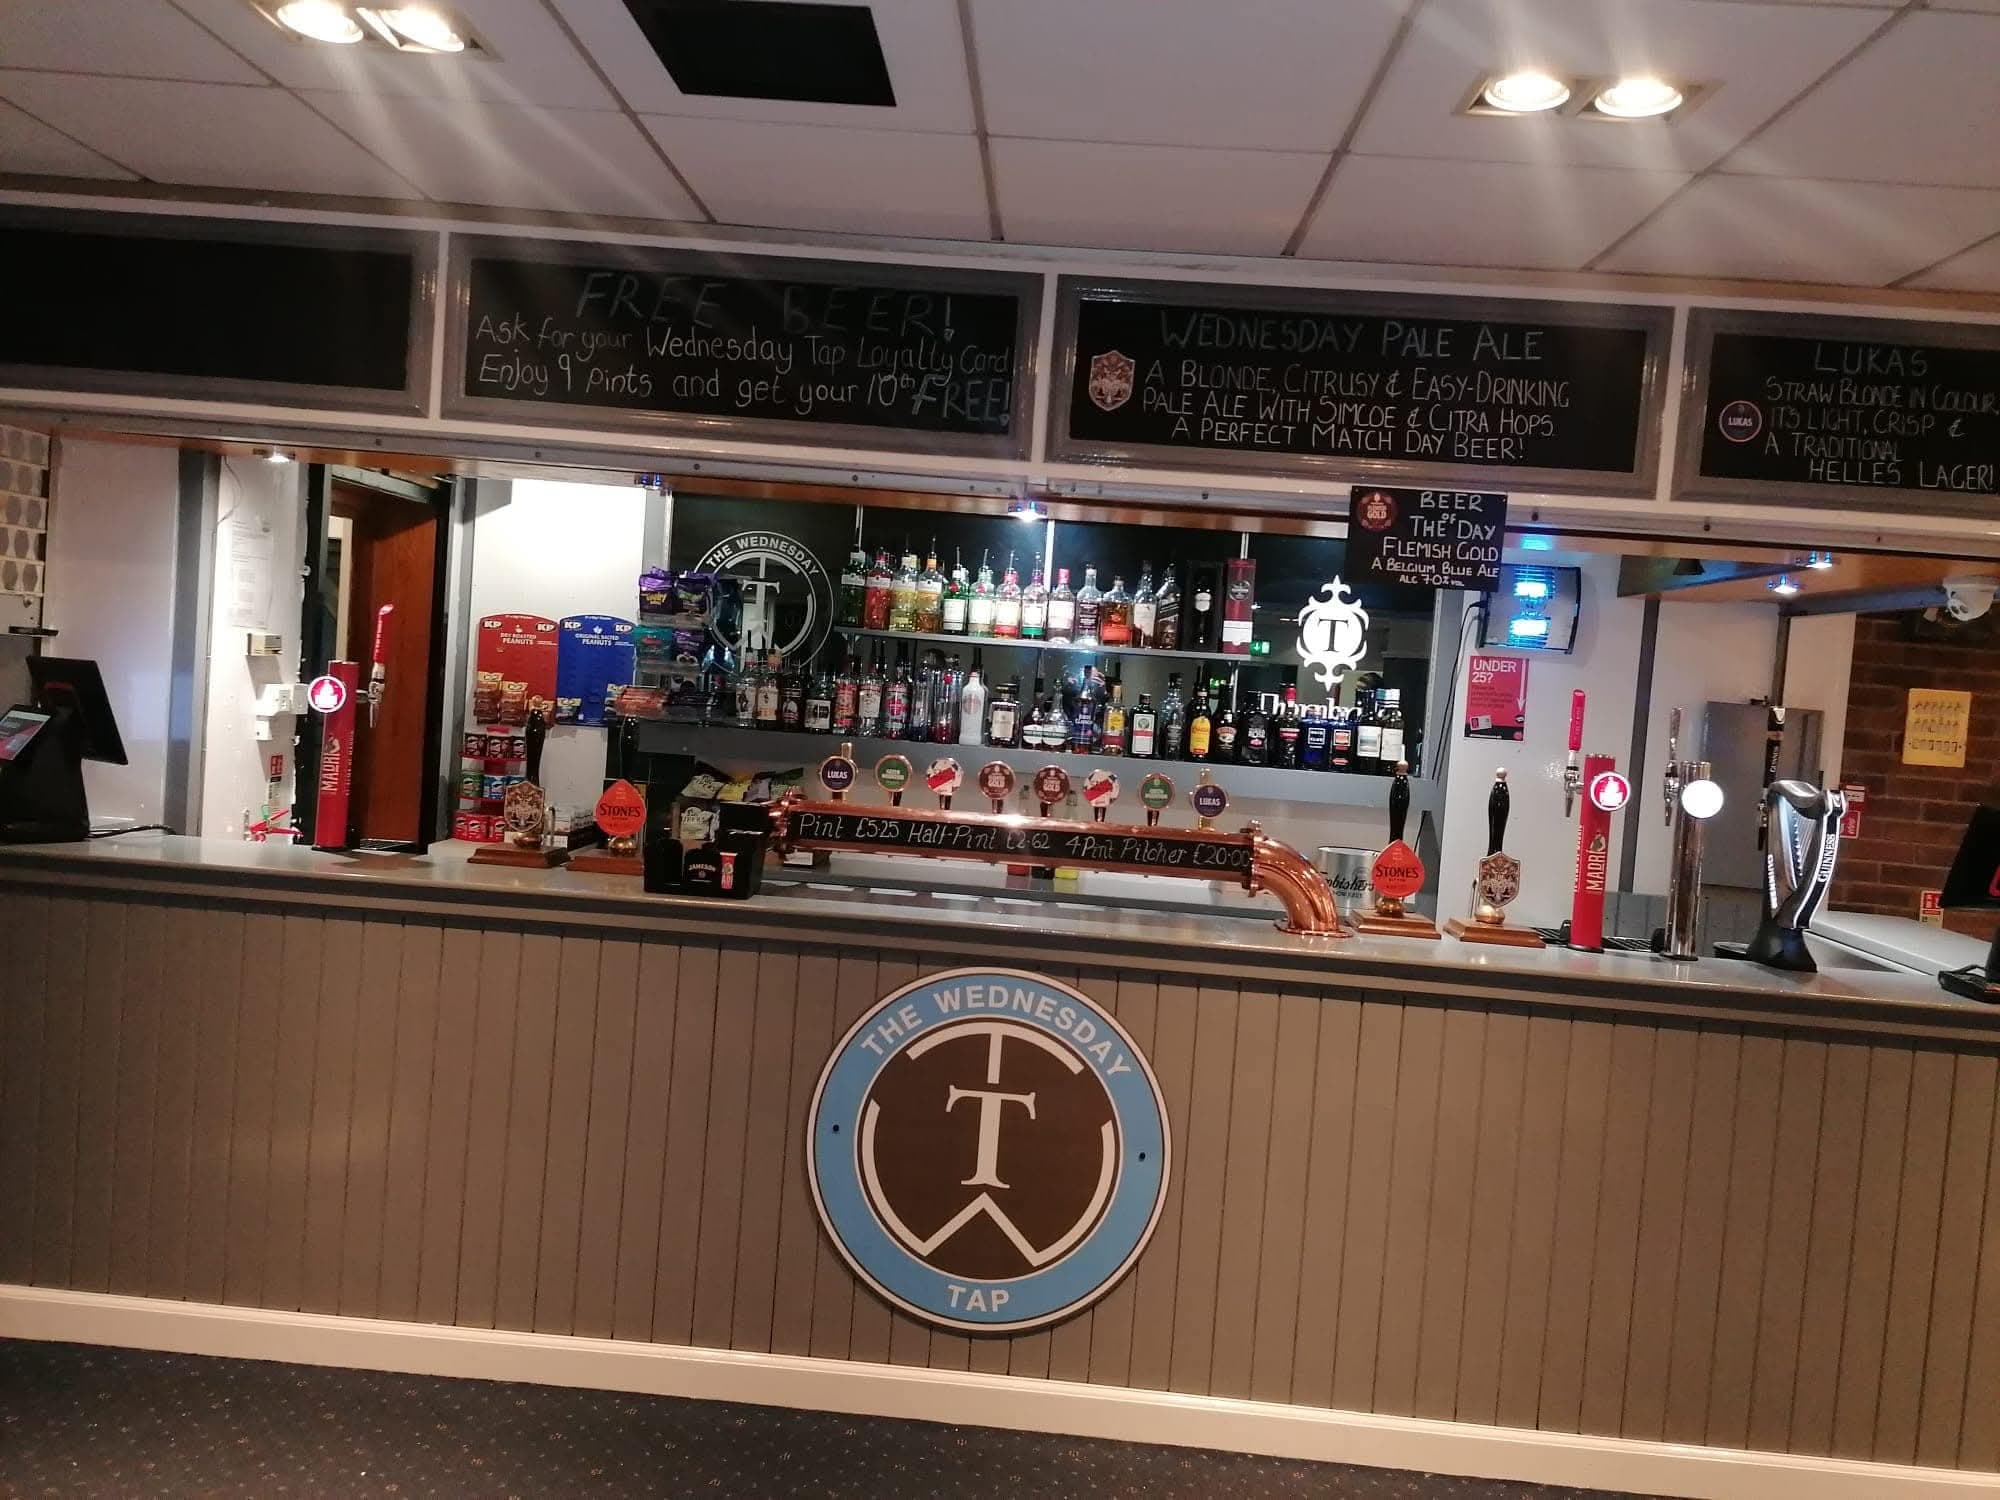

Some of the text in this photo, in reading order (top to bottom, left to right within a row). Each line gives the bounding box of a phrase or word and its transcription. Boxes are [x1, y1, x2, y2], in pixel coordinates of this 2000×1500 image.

[575, 271, 954, 343] FREE BEER!
[475, 315, 532, 344] Ask
[537, 317, 575, 348] for
[575, 330, 634, 363] your
[645, 323, 794, 377] Wednesday
[805, 335, 847, 376] Tap
[1160, 308, 1544, 362] WEDNESDAY PALE ALE
[1813, 342, 1928, 378] LUKAS
[479, 352, 551, 392] Enjoy
[558, 349, 573, 378] 9
[673, 372, 722, 400] and
[735, 375, 786, 409] get
[795, 382, 859, 416] your
[911, 373, 1011, 428] FREE!
[1144, 360, 1166, 384] A
[1283, 367, 1381, 399] CITRUSY
[1385, 370, 1402, 398] &
[1412, 368, 1571, 408] EASY-DRINKING
[1766, 375, 1834, 404] STRAW
[1839, 376, 1905, 409] BLONDE
[1909, 384, 1926, 408] IN
[1142, 387, 1194, 415] PALE
[1202, 393, 1251, 420] ALE
[1258, 396, 1310, 423] WITH
[1317, 396, 1397, 430] SIMCOE
[1406, 407, 1423, 429] &
[1429, 403, 1489, 433] CITRA
[1727, 416, 1753, 428] LUKAS
[1872, 408, 1937, 435] CRISP
[1171, 416, 1524, 460] A PERFECT MATCH DAY BEER!
[1764, 431, 1905, 462] A TRADITIONAL
[1808, 458, 1994, 490] HELLES LAGER!
[1420, 491, 1484, 513] BEER
[1409, 515, 1497, 541] THE DAY
[705, 536, 820, 577] THE WEDNESDAY
[1382, 536, 1500, 563] FLEMISH GOLD
[1370, 557, 1500, 578] A BELGIUM BLUE ALE
[1399, 574, 1418, 585] ALC
[482, 620, 502, 629] KP
[537, 623, 556, 632] KP
[563, 621, 582, 629] KP
[615, 624, 633, 632] KP
[502, 637, 534, 646] PEANUTS
[582, 638, 612, 647] PEANUTS
[1471, 671, 1494, 683] 25?
[1473, 658, 1517, 673] UNDER
[827, 770, 849, 780] LUKAS
[599, 803, 642, 818] STONES
[1200, 797, 1221, 807] LUKAS
[800, 813, 844, 839] Pint
[688, 863, 717, 873] JAMESON
[1816, 833, 1838, 884] GUINNESS
[1375, 865, 1420, 880] STONES
[860, 984, 1133, 1078] THE WEDNESDAY
[947, 1283, 1011, 1313] TAP
